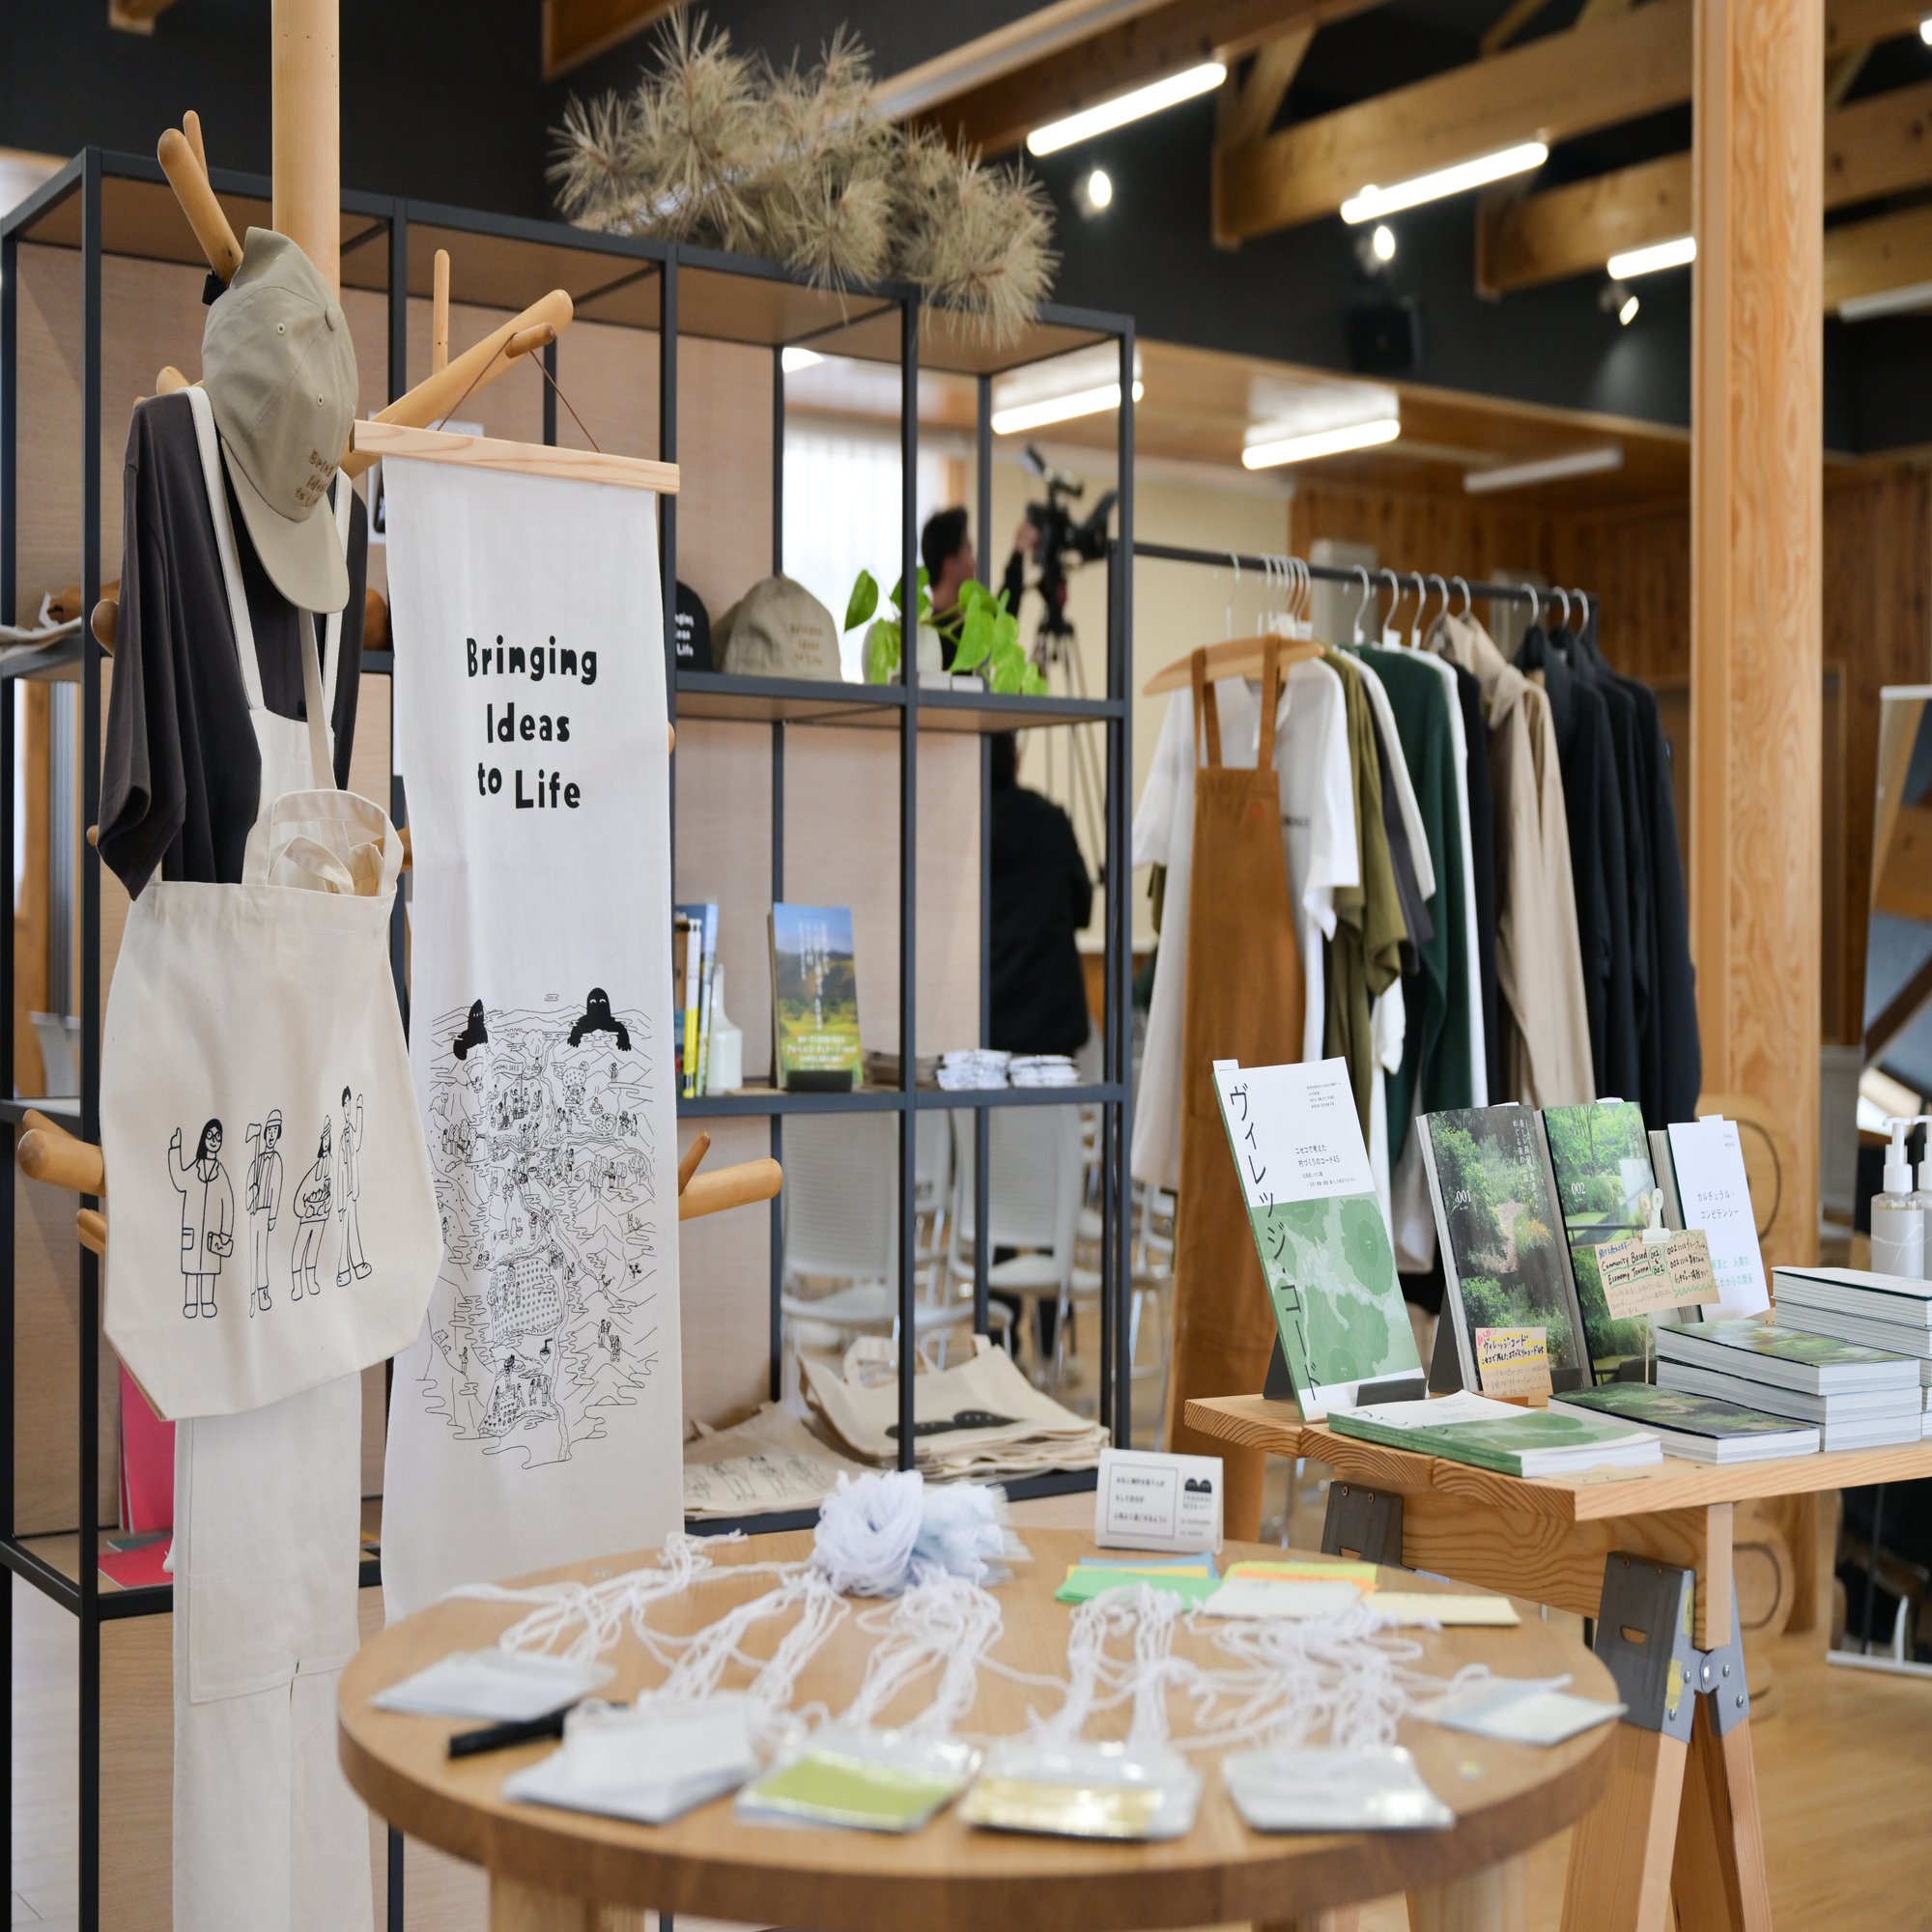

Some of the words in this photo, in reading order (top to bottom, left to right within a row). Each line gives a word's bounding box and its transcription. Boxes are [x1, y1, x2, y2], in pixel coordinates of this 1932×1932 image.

[467, 635, 597, 685] Bringing
[487, 702, 570, 743] Ideas
[478, 762, 502, 796] to
[516, 769, 581, 809] Life
[1456, 1190, 1471, 1203] 001
[1571, 1182, 1587, 1195] 002
[1230, 1082, 1321, 1401] ヴィレッジ・コード
[1631, 1248, 1648, 1264] Based
